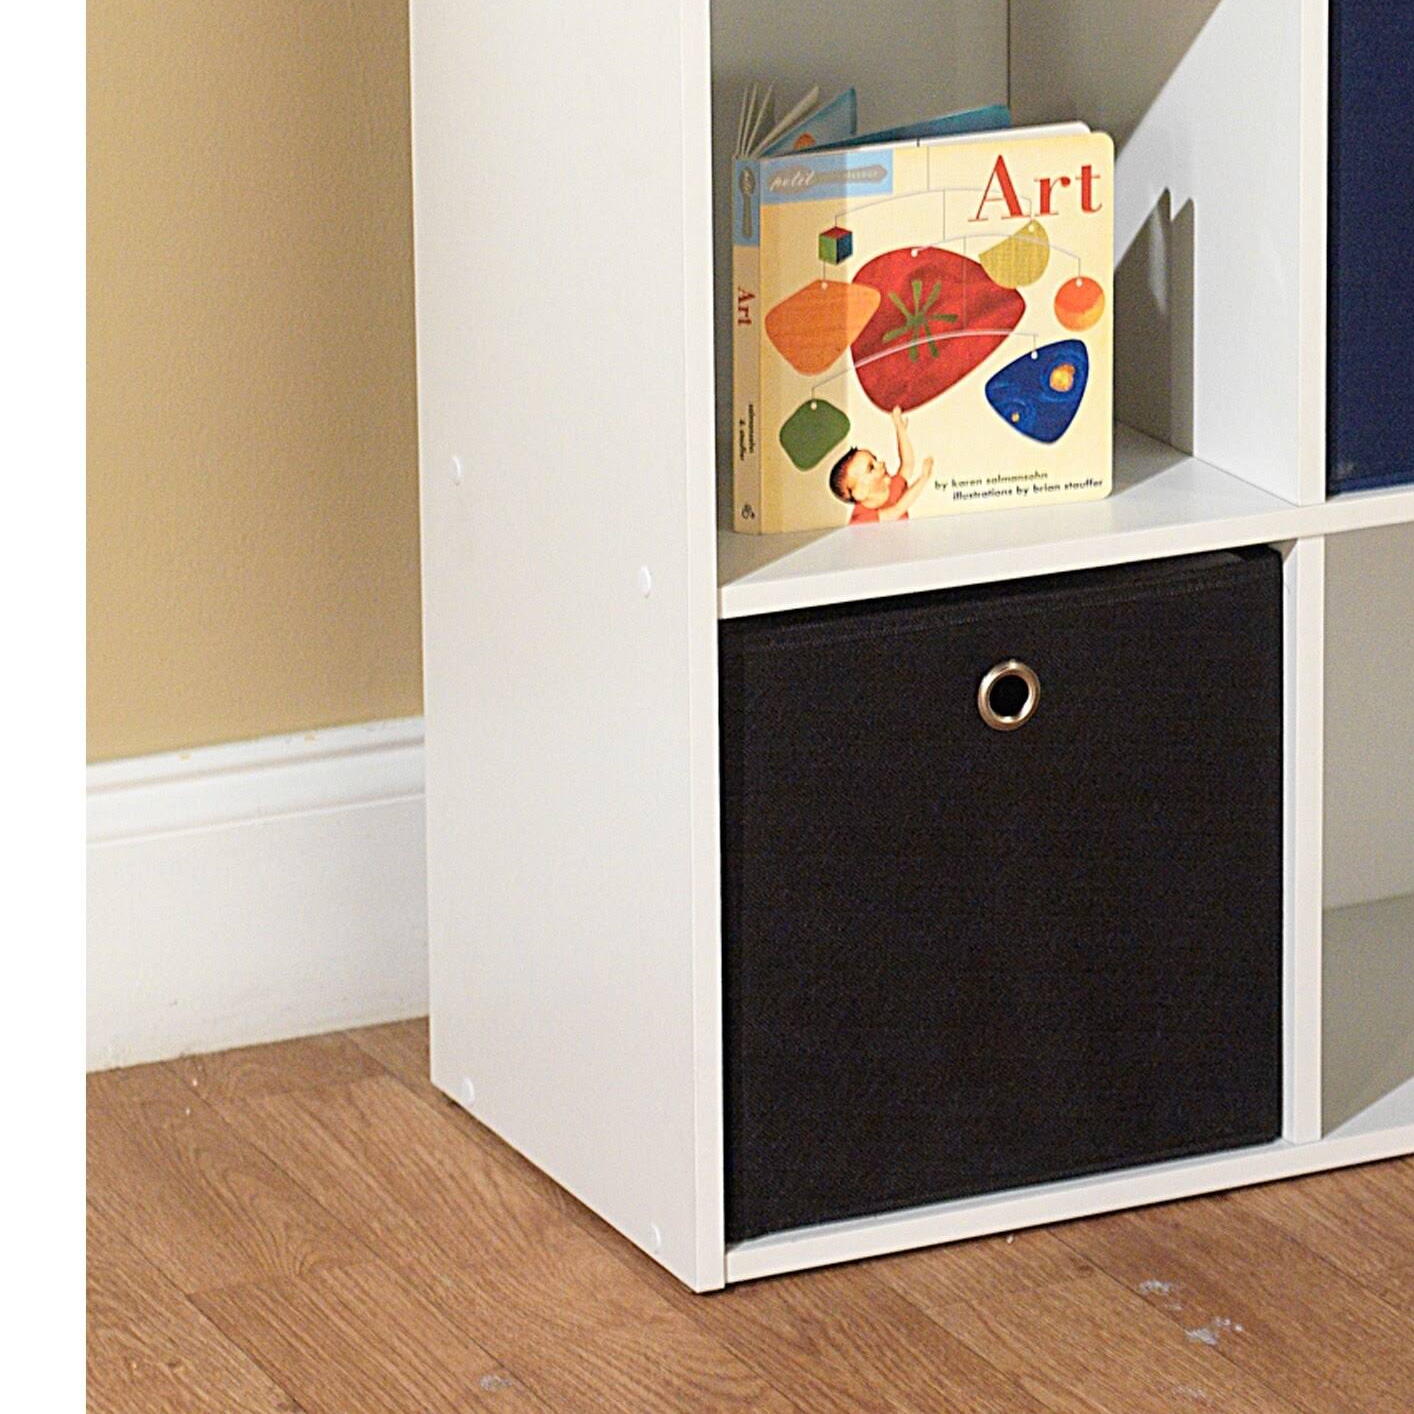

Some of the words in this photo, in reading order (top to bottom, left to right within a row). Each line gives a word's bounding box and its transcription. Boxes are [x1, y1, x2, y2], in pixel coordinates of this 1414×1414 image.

[967, 154, 1103, 223] Art
[738, 286, 755, 326] Art
[935, 480, 948, 491] by
[951, 478, 983, 489] karen
[953, 487, 1013, 502] illustrations
[1016, 485, 1029, 497] by
[1033, 482, 1061, 494] brian
[1064, 478, 1103, 491] stauffer
